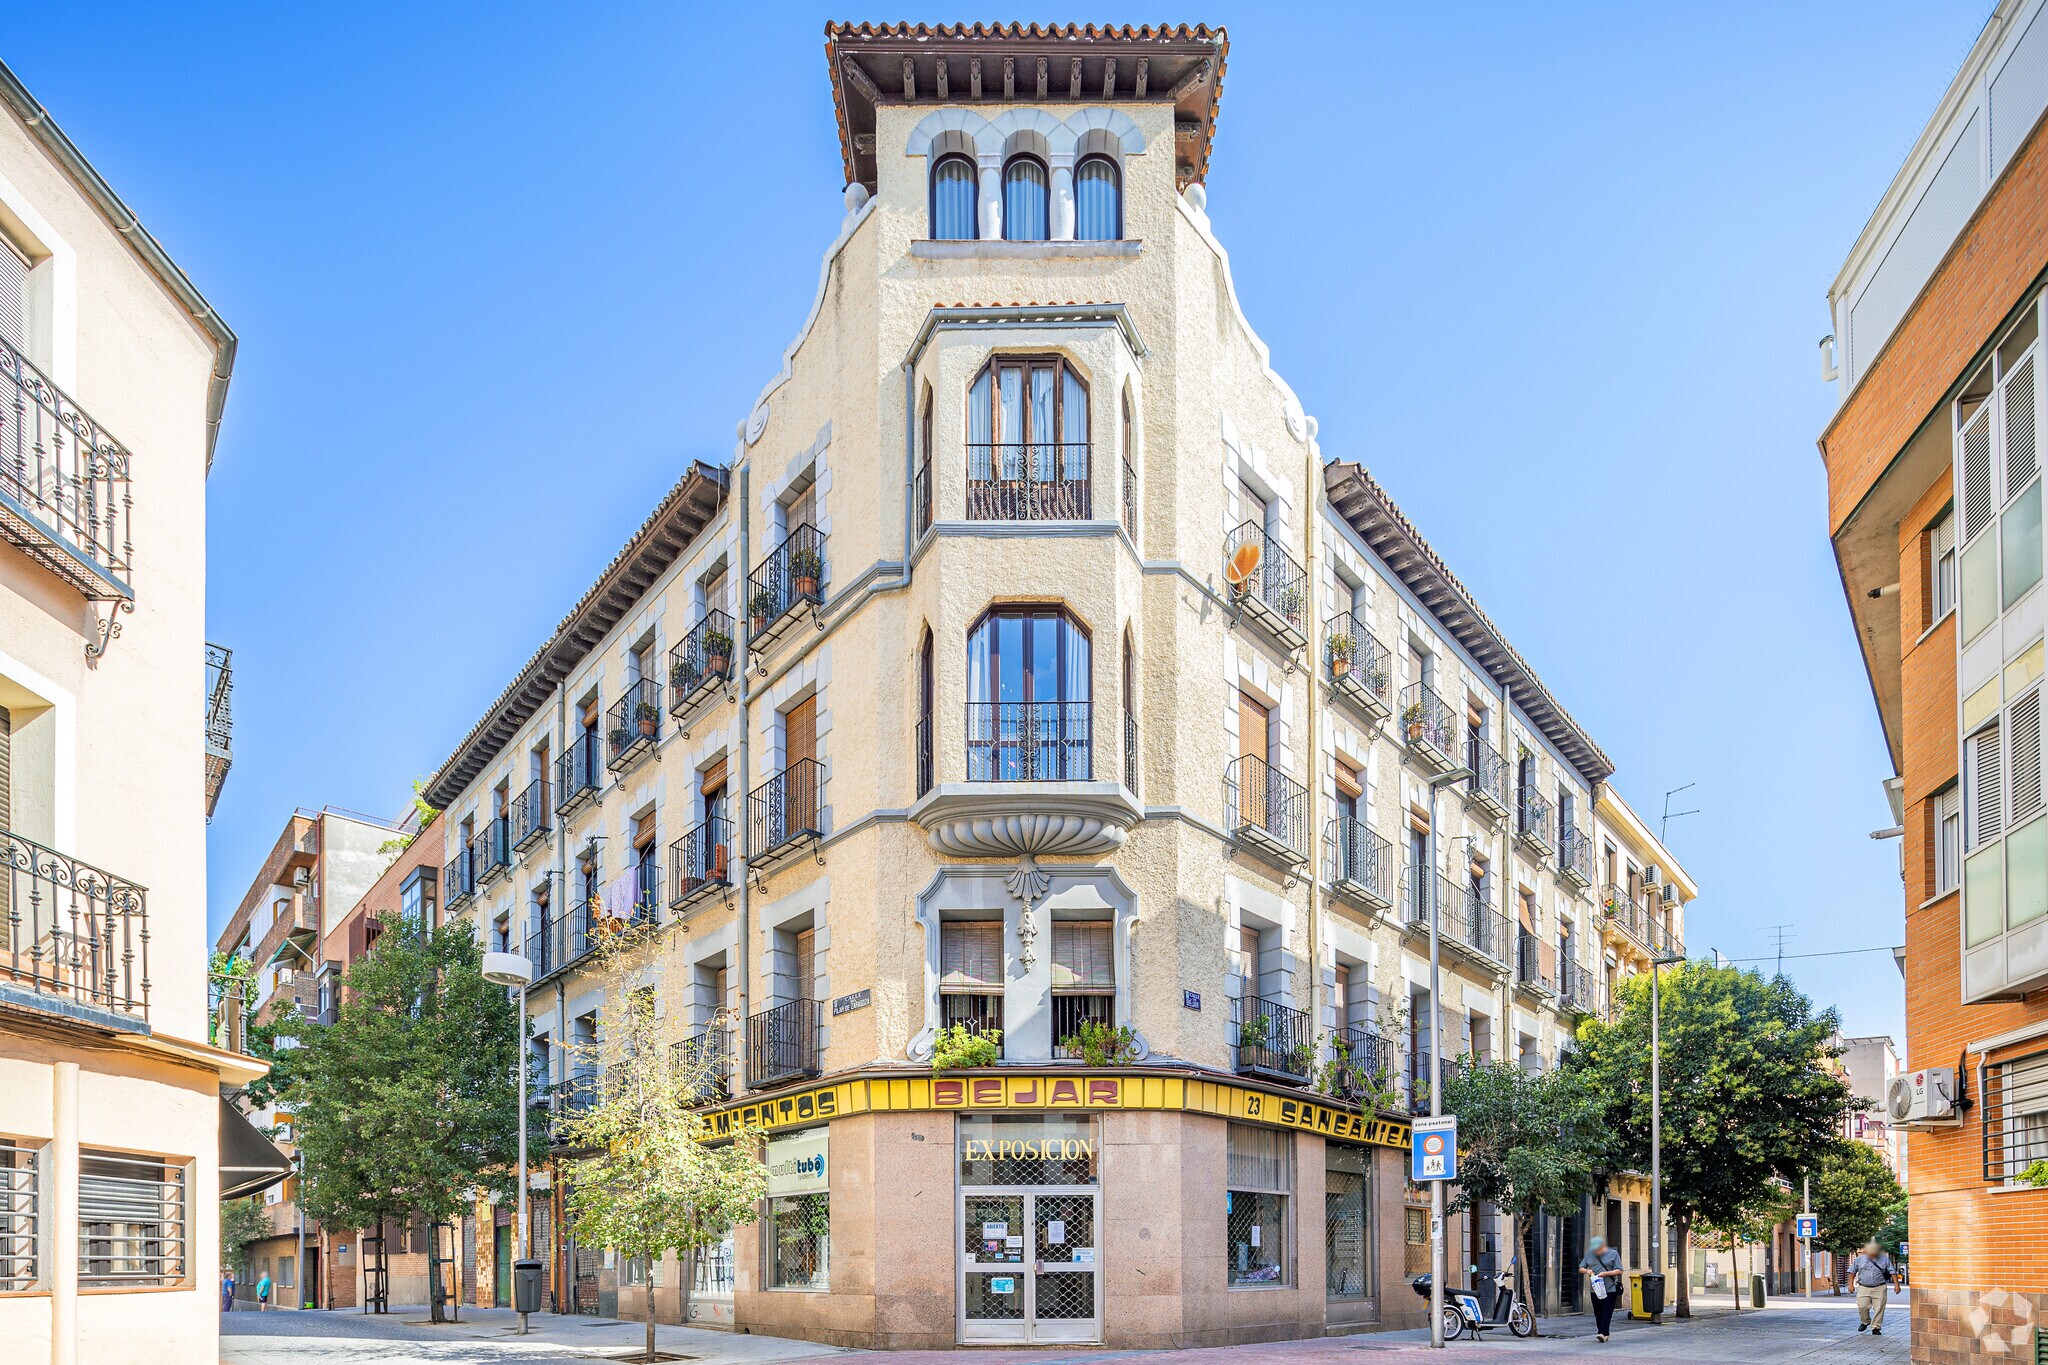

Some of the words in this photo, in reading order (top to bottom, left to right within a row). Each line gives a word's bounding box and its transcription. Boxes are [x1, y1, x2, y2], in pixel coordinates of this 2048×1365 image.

[834, 1006, 844, 1015] PILAR
[845, 1004, 850, 1012] DE
[850, 998, 870, 1010] ZARAGOZA
[845, 993, 861, 1001] CALLE
[935, 1080, 1118, 1105] BEJAR
[702, 1091, 835, 1135] AMIENTOS
[1248, 1096, 1260, 1115] 23
[1281, 1101, 1412, 1146] SANEAMIEN
[965, 1138, 1094, 1161] EXPOSICION
